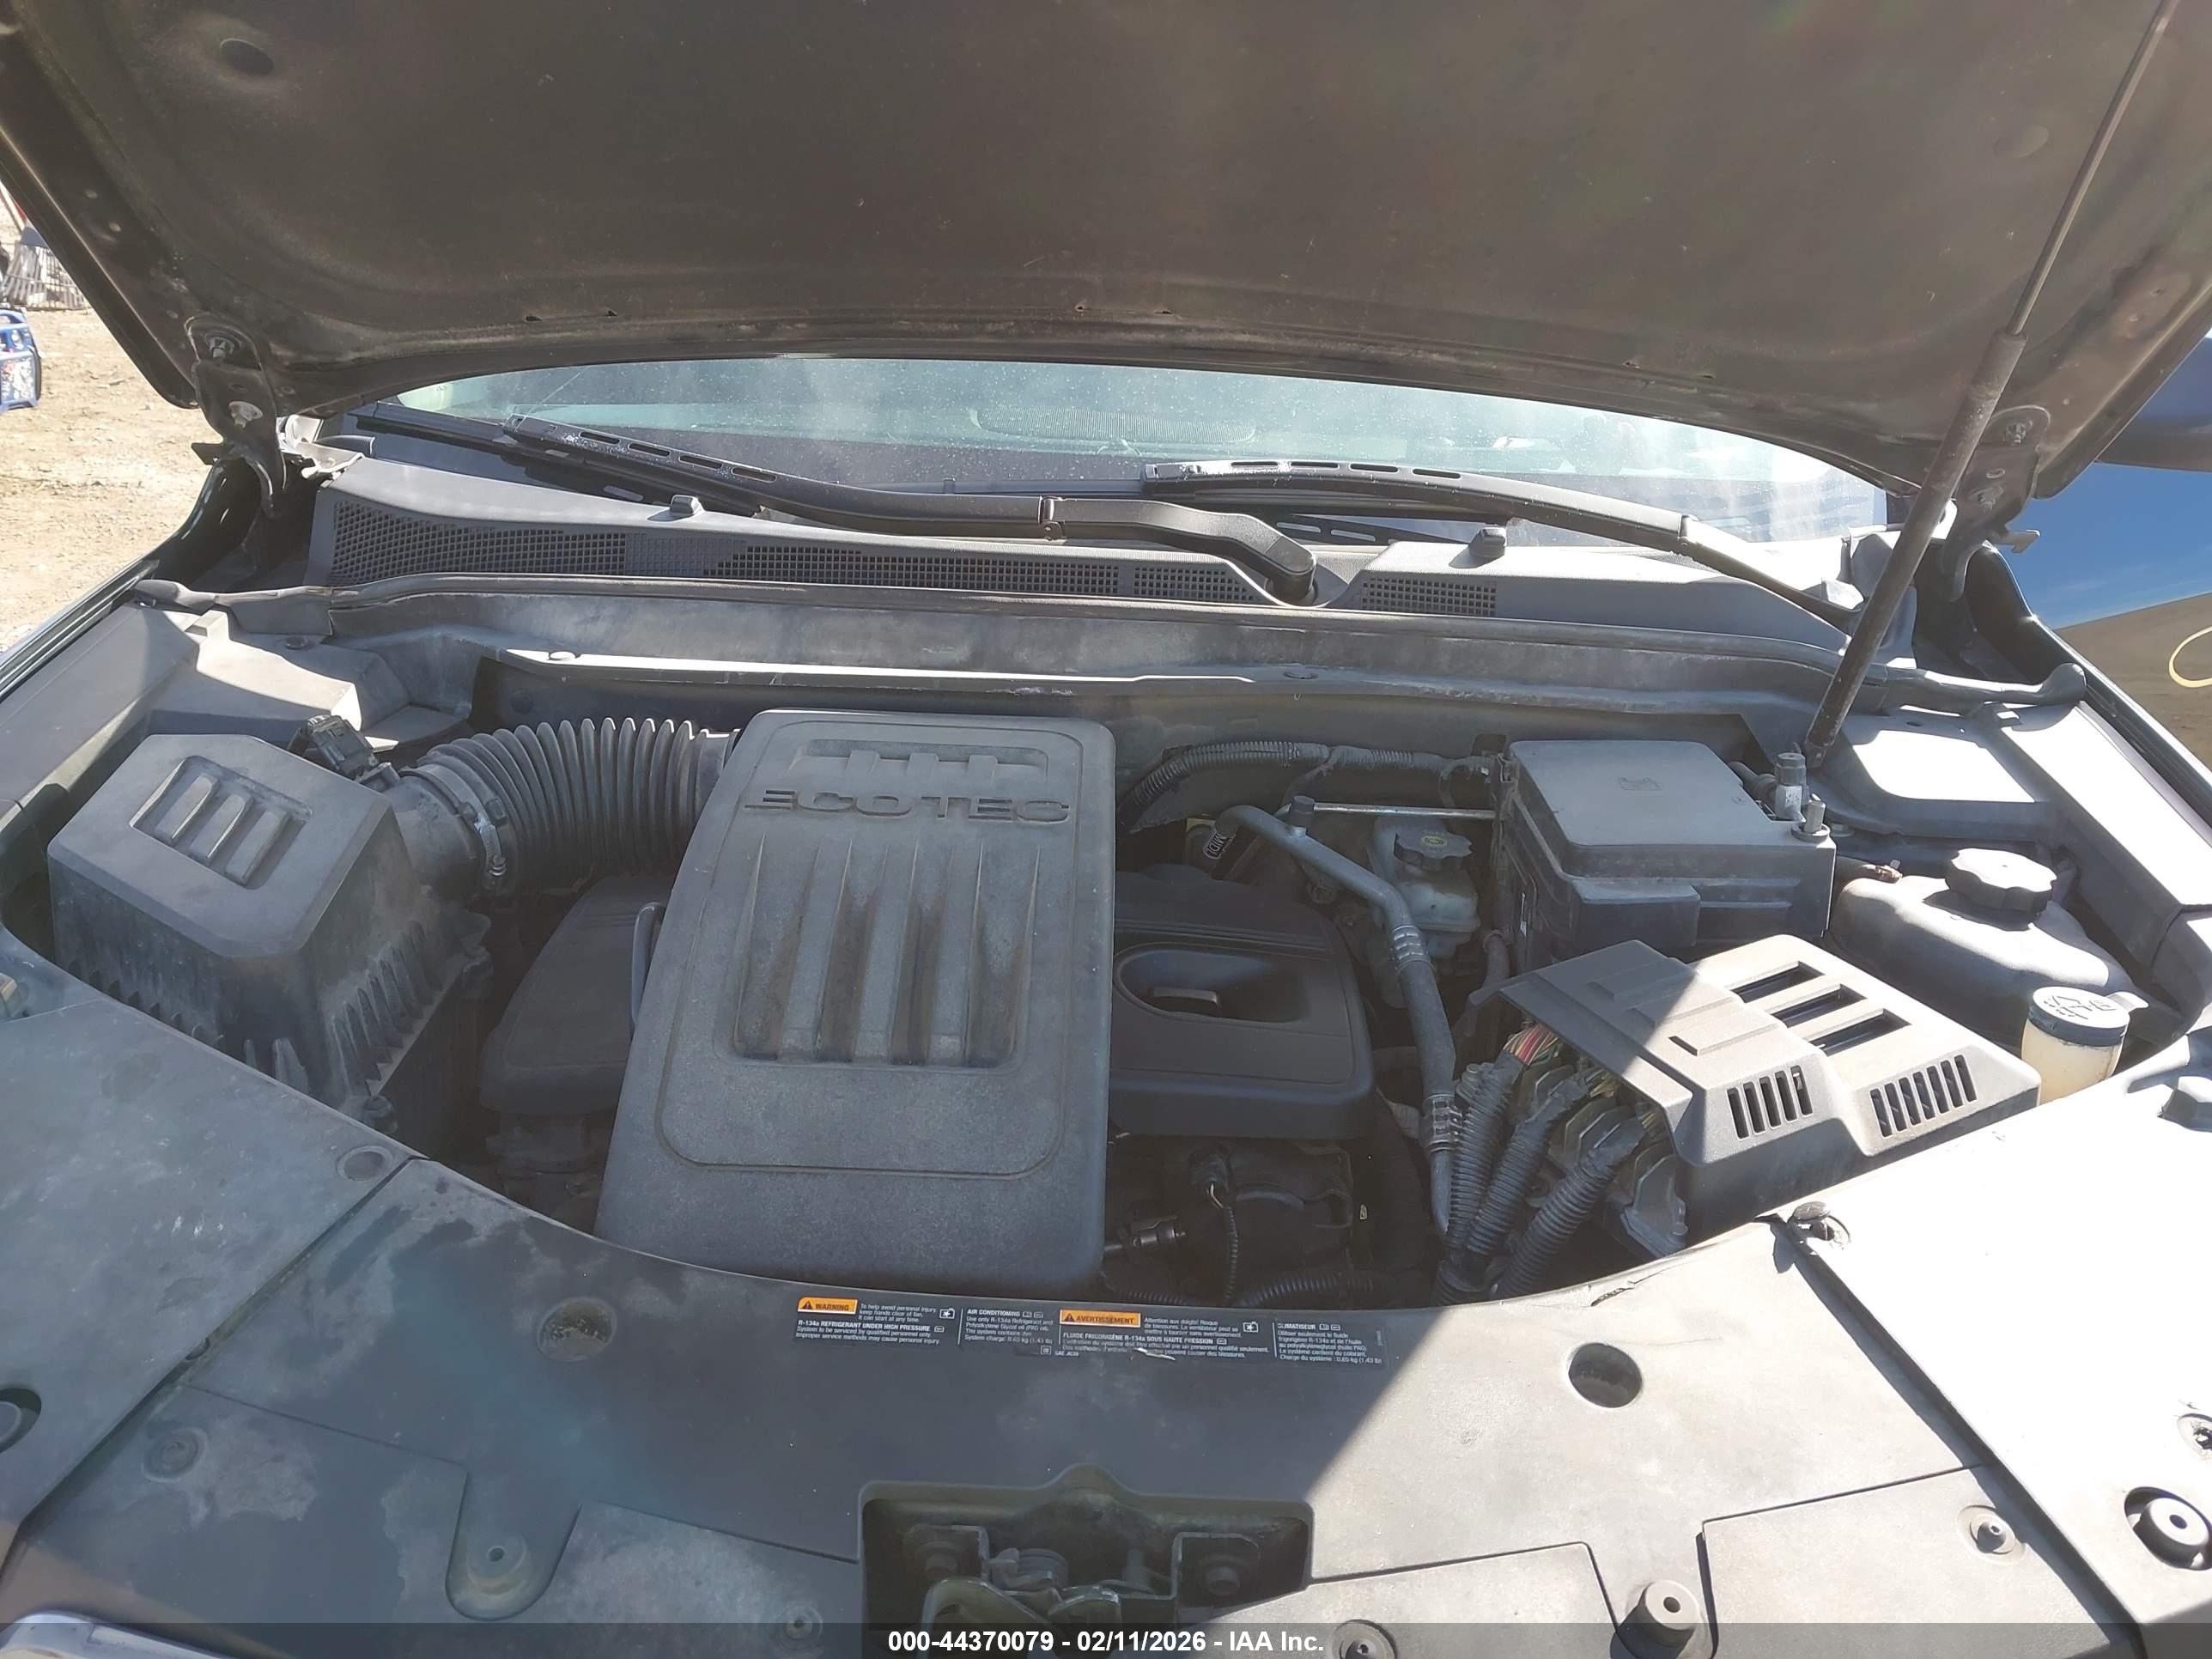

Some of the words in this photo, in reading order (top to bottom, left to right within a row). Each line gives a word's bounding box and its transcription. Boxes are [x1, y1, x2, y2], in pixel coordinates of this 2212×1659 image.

[744, 789, 1071, 823] ECOTEC
[816, 1303, 849, 1311] WARNING
[1077, 1315, 1133, 1324] AVERTISSEMENT
